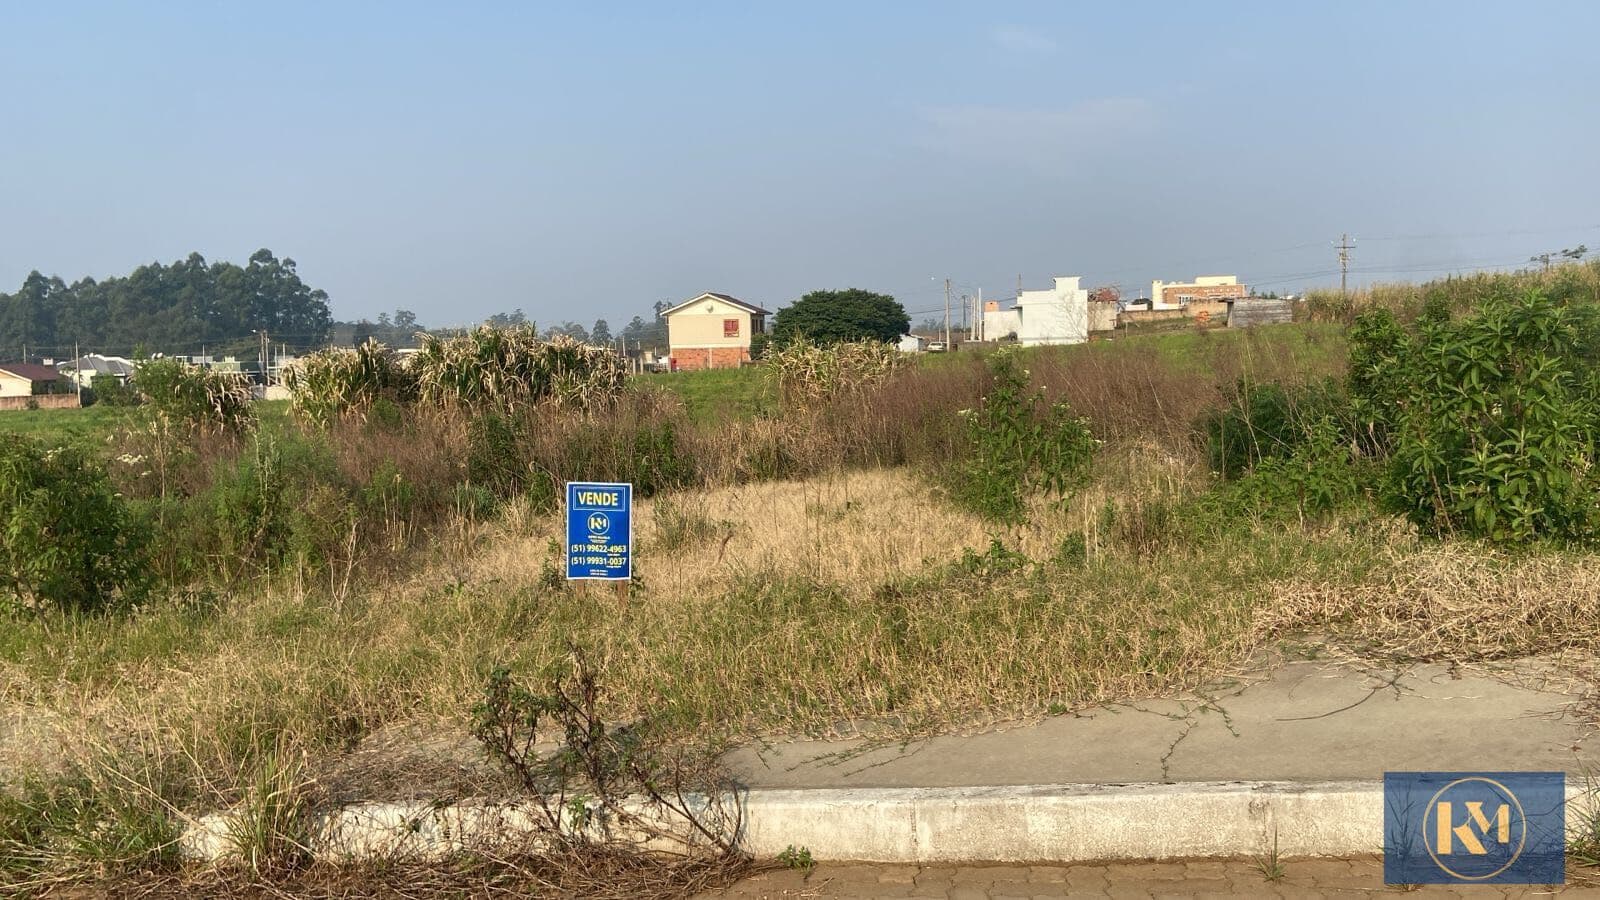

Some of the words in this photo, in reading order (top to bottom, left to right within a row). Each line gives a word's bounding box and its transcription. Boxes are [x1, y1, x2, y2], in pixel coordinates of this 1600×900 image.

[577, 491, 618, 506] VENDE
[571, 544, 585, 553] (51)
[587, 544, 627, 553] 99622-4963
[571, 557, 585, 565] (51)
[587, 557, 627, 565] 99931-0037
